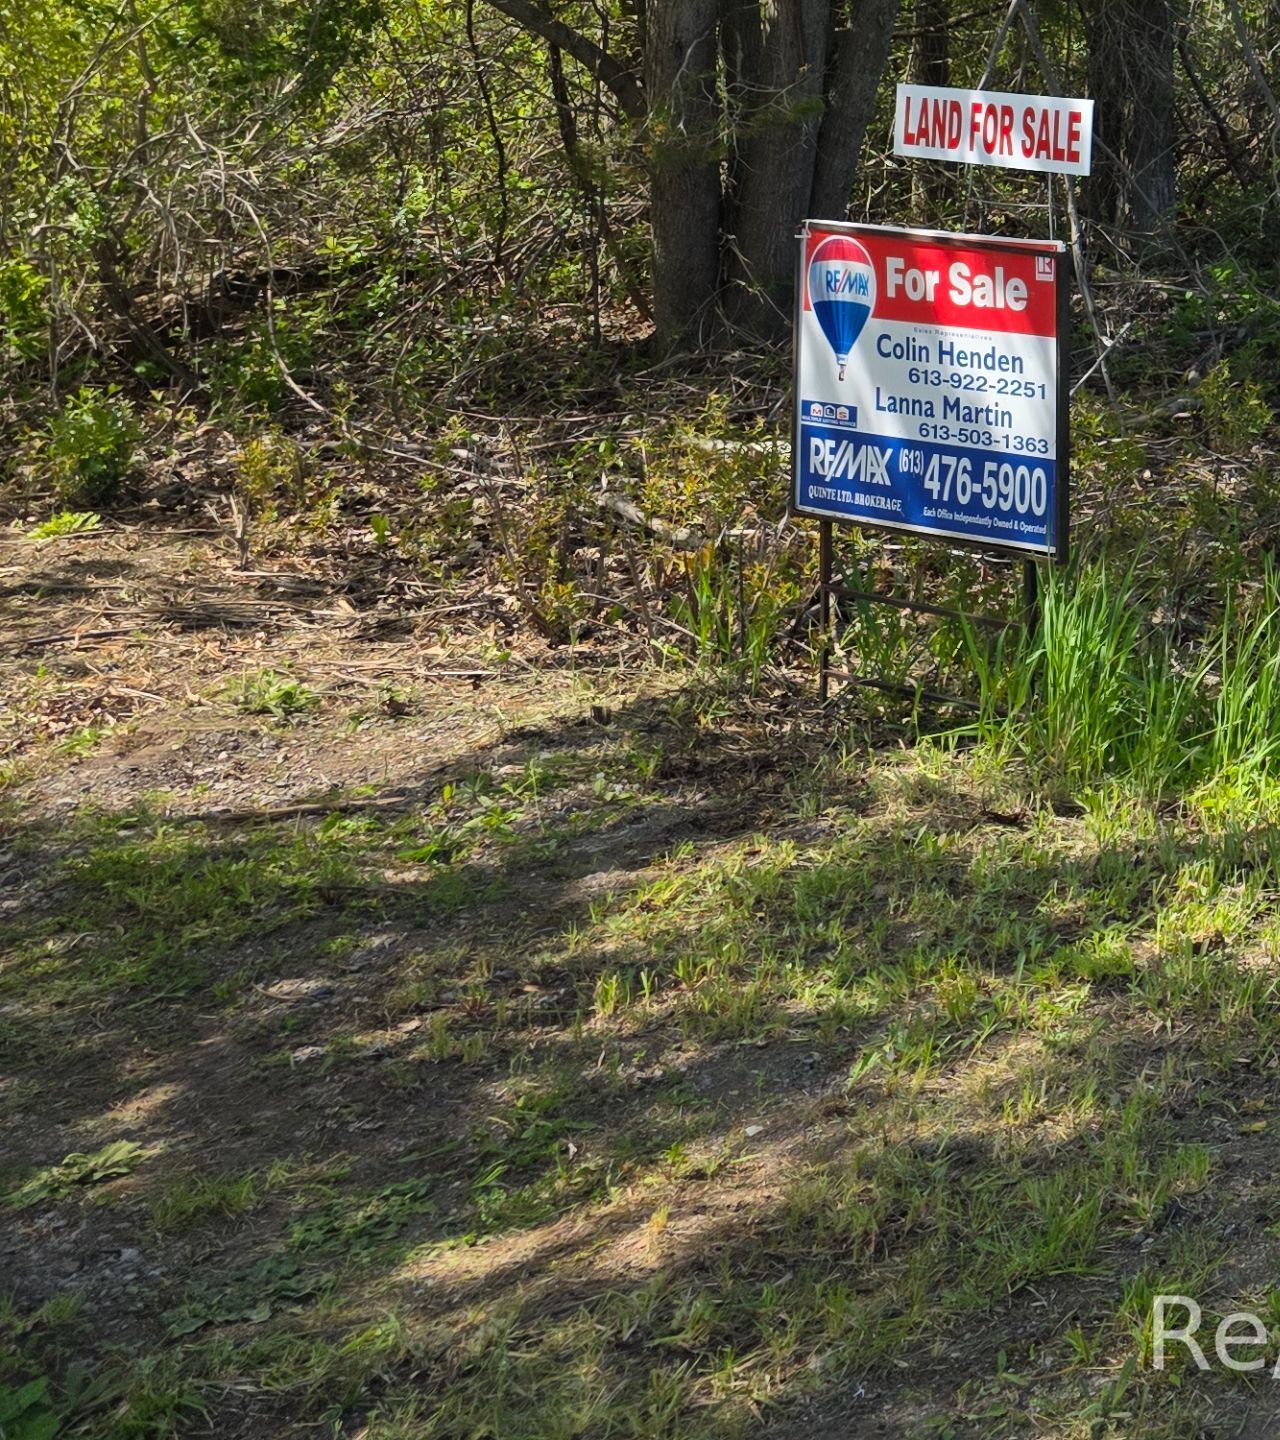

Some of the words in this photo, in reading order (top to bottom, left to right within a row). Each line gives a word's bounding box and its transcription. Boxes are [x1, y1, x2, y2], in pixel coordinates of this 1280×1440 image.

[903, 96, 962, 150] LAND
[969, 102, 1015, 156] FOR
[1021, 106, 1082, 163] SALE
[825, 268, 870, 297] RE/MAX
[886, 256, 940, 302] For
[949, 262, 1028, 311] Sale
[876, 334, 930, 364] Colin
[938, 340, 1024, 374] Henden
[908, 367, 1046, 400] 613-922-2251
[875, 386, 935, 418] Lanna
[943, 395, 1013, 428] Martin
[919, 422, 1049, 454] 613-503-1363
[809, 436, 894, 486] RE/MAX
[808, 484, 837, 501] QUINTE
[854, 492, 903, 512] BROKERAGE
[899, 447, 925, 476] (613)
[924, 453, 1047, 517] 476-5900
[923, 506, 937, 518] Each
[937, 508, 953, 521] Office
[953, 511, 993, 529] Independently
[993, 517, 1013, 530] Owned
[1013, 521, 1019, 530] &
[1019, 521, 1047, 535] Operated
